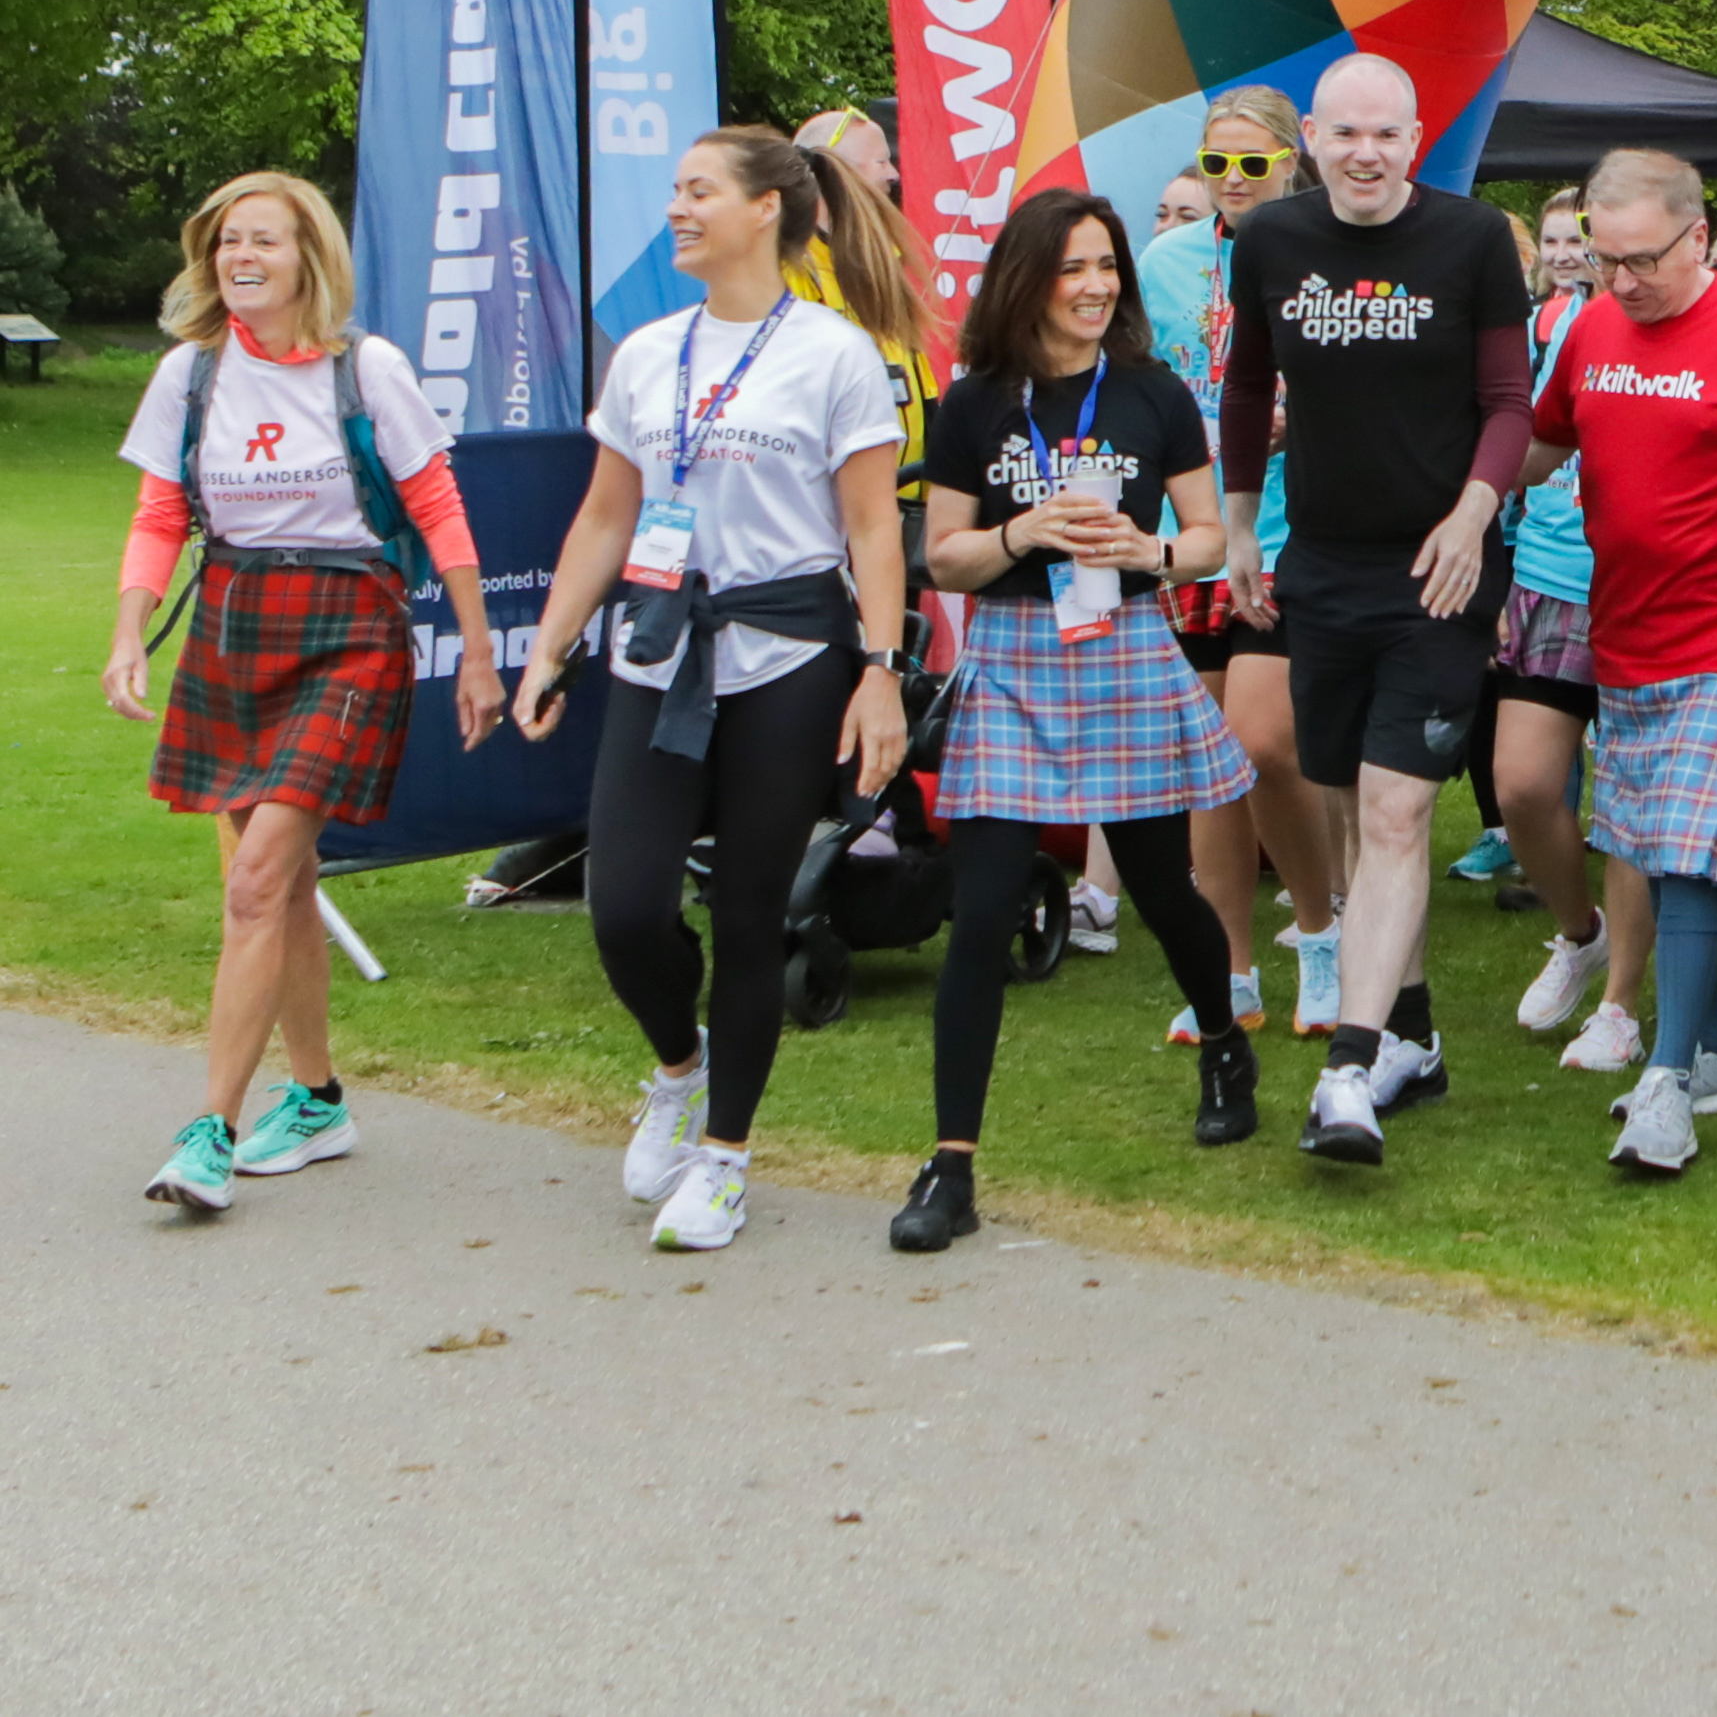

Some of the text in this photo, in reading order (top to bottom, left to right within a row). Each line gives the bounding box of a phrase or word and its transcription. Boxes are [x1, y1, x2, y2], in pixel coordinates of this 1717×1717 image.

[1281, 288, 1434, 321] children's
[1302, 310, 1418, 347] appeal
[1596, 363, 1706, 401] kiltwalk
[656, 448, 756, 465] FODATION
[203, 471, 246, 486] SSELL
[213, 490, 317, 503] FOUNDATION
